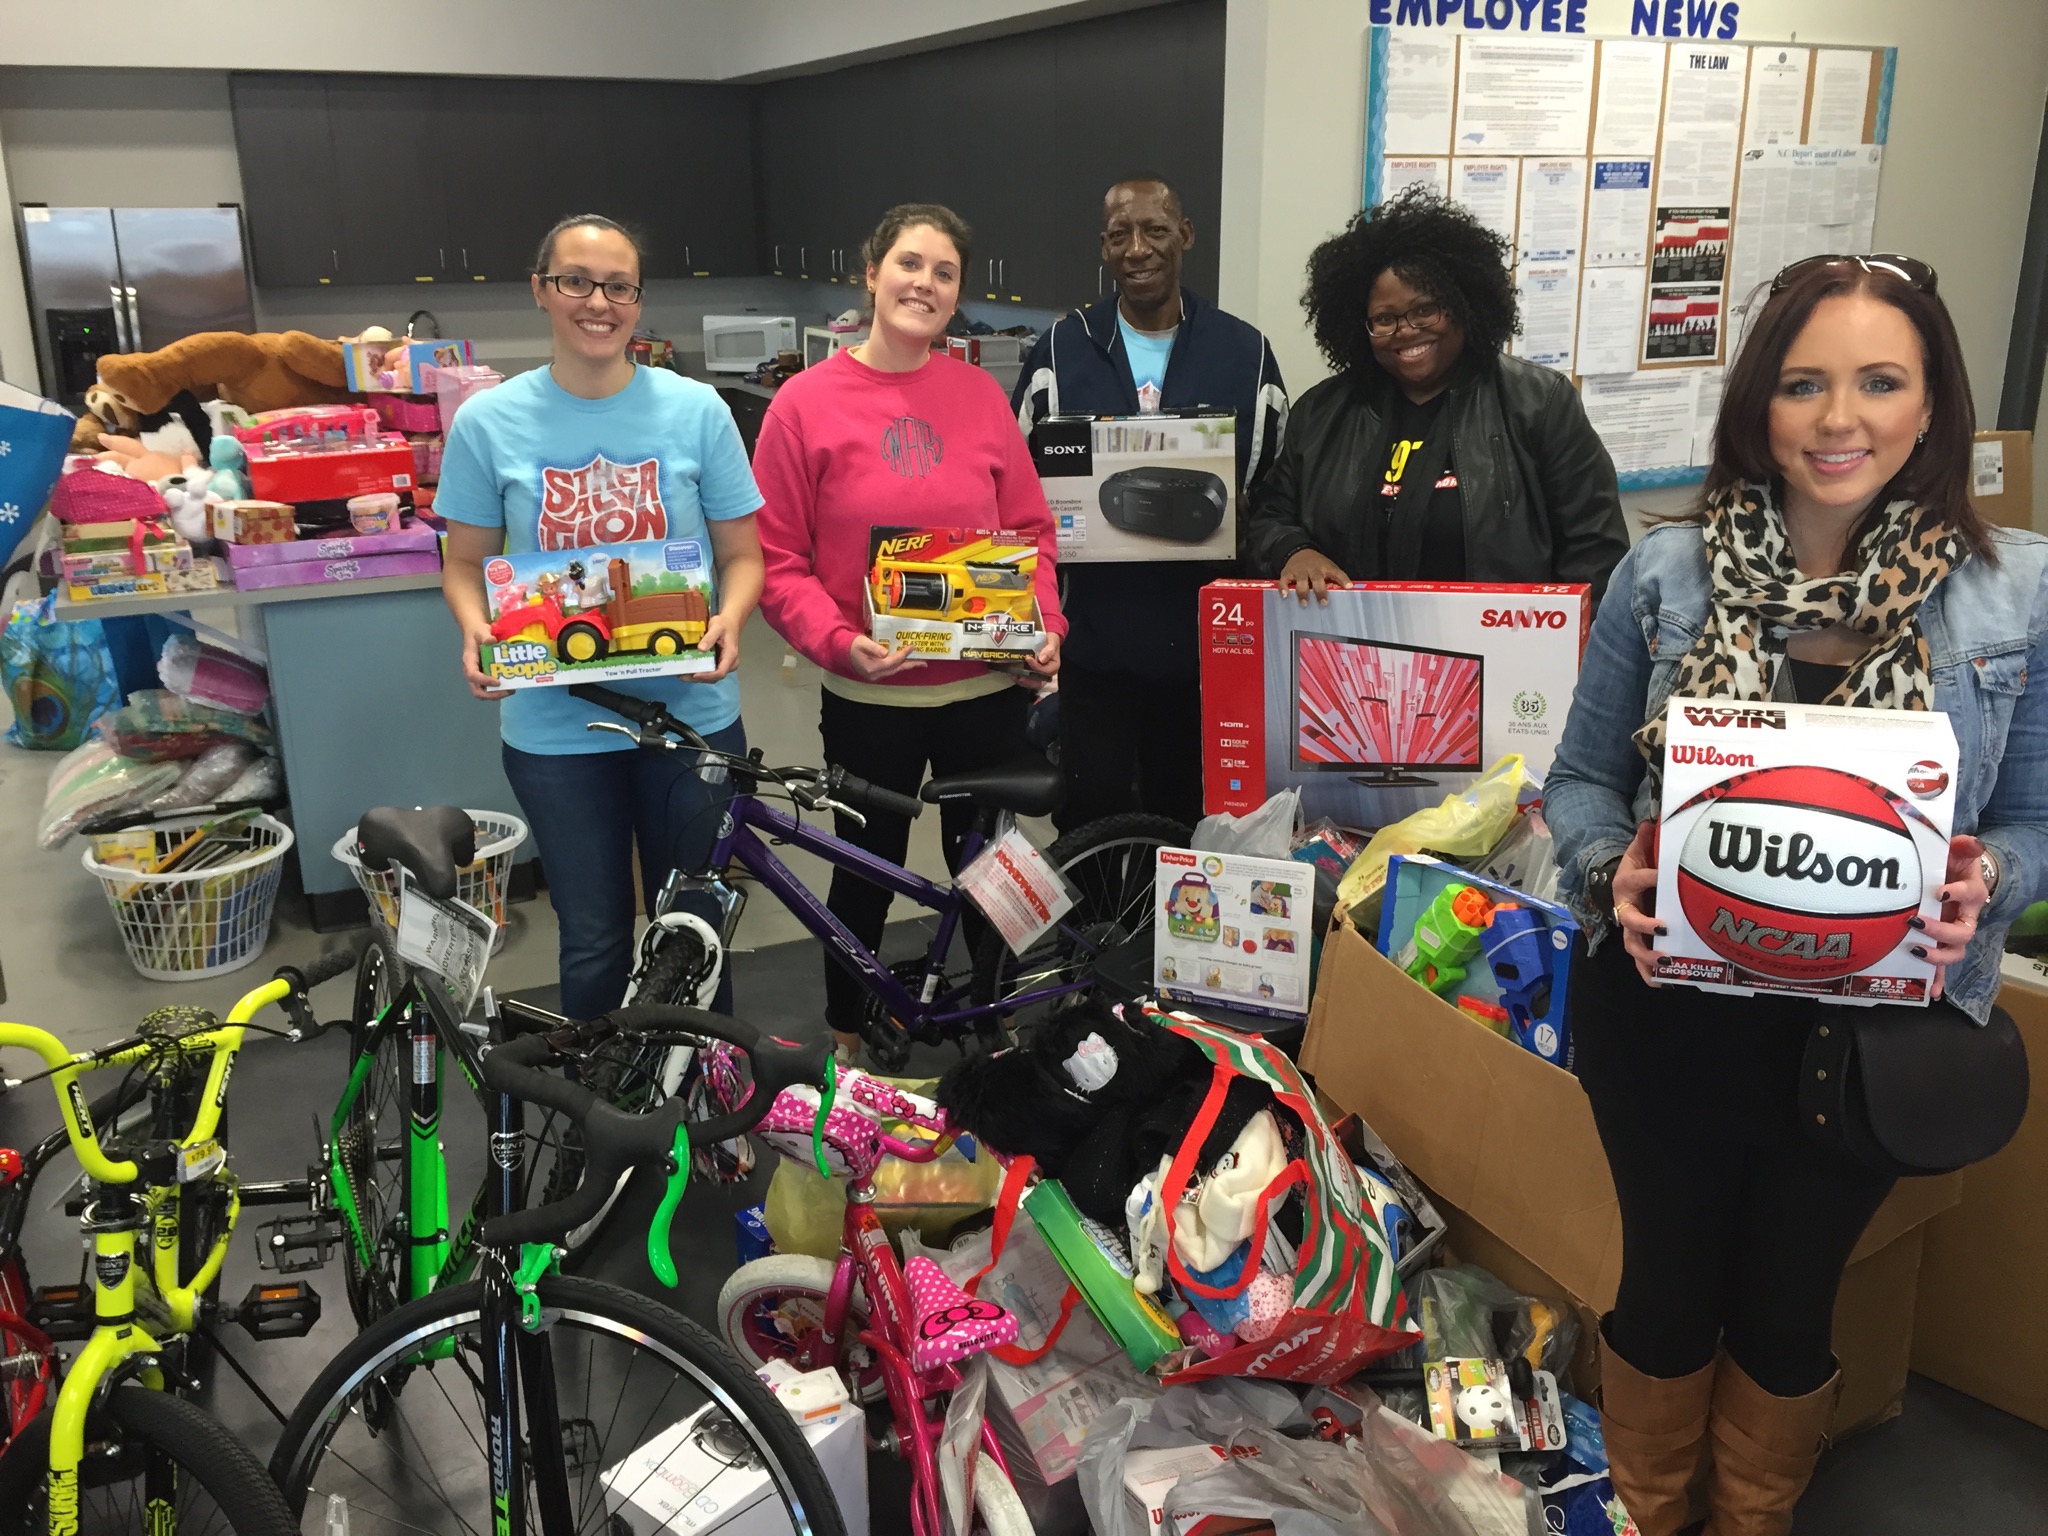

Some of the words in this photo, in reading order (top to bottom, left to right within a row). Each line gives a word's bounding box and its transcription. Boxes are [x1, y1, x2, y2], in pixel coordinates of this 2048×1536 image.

[1369, 0, 1586, 33] EMPLOYEE
[1631, 0, 1739, 40] NEWS
[1690, 54, 1706, 69] THE
[1708, 56, 1729, 70] LAW
[1391, 161, 1417, 169] EMPLOYEE
[1418, 161, 1437, 169] RIGHTS
[1463, 164, 1489, 172] EMPLOYEE
[1044, 445, 1087, 455] SONY
[877, 534, 934, 557] NERF
[975, 573, 1000, 583] NERF
[1211, 602, 1244, 626] 24
[1245, 620, 1255, 629] po
[1480, 606, 1567, 631] SANYO
[967, 623, 1030, 632] N-STRIKE
[895, 631, 952, 640] QUICK-FIRING
[1211, 633, 1255, 646] LED
[493, 641, 547, 664] Little
[962, 650, 1010, 659] MAVERICK
[1212, 647, 1231, 655] HDTV
[1232, 647, 1242, 655] ACL
[1243, 647, 1255, 655] DEL
[490, 659, 558, 679] People
[1519, 698, 1540, 713] 35
[1684, 706, 1786, 718] MORE
[1519, 721, 1532, 729] ANS
[1533, 722, 1548, 730] AUX
[1685, 714, 1787, 730] WIN
[1671, 744, 1755, 767] Wilson
[1708, 820, 1902, 890] Wilson
[993, 849, 1053, 926] ROADMASTER
[427, 913, 440, 958] WARNING
[1709, 907, 1853, 960] NCAA
[830, 934, 877, 976] 24
[1659, 965, 1721, 980] CROSSOVER
[1690, 963, 1723, 974] KILLER
[1869, 987, 1906, 995] OFFICIAL
[1539, 1026, 1554, 1042] 17
[492, 1142, 525, 1154] KENT
[958, 1339, 977, 1350] HELLO
[976, 1331, 999, 1347] KITTY
